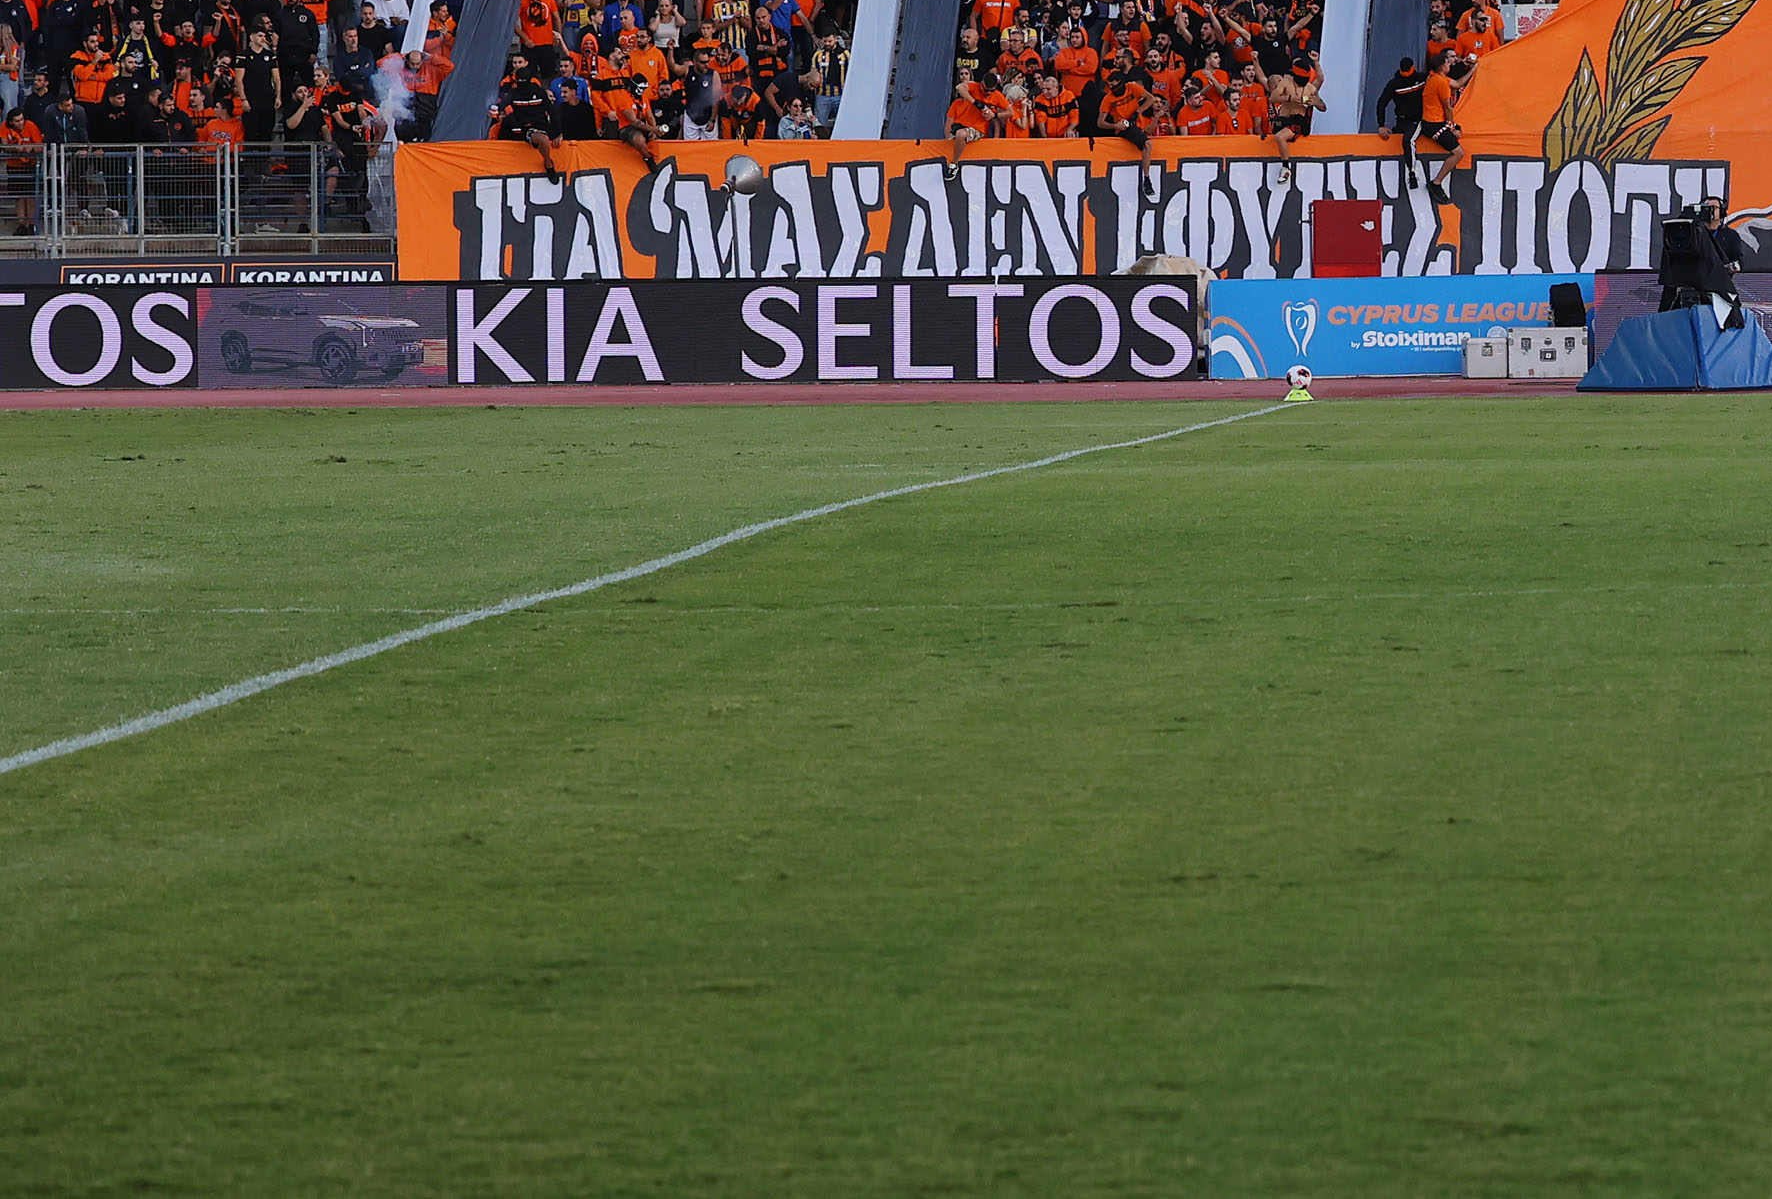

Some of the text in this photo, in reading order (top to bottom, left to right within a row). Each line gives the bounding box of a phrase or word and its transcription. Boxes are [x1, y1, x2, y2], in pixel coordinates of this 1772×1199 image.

[1327, 304, 1441, 325] CYPRUS
[456, 283, 1190, 383] KIA SELTOS
[1351, 330, 1472, 350] by Stoiximan
